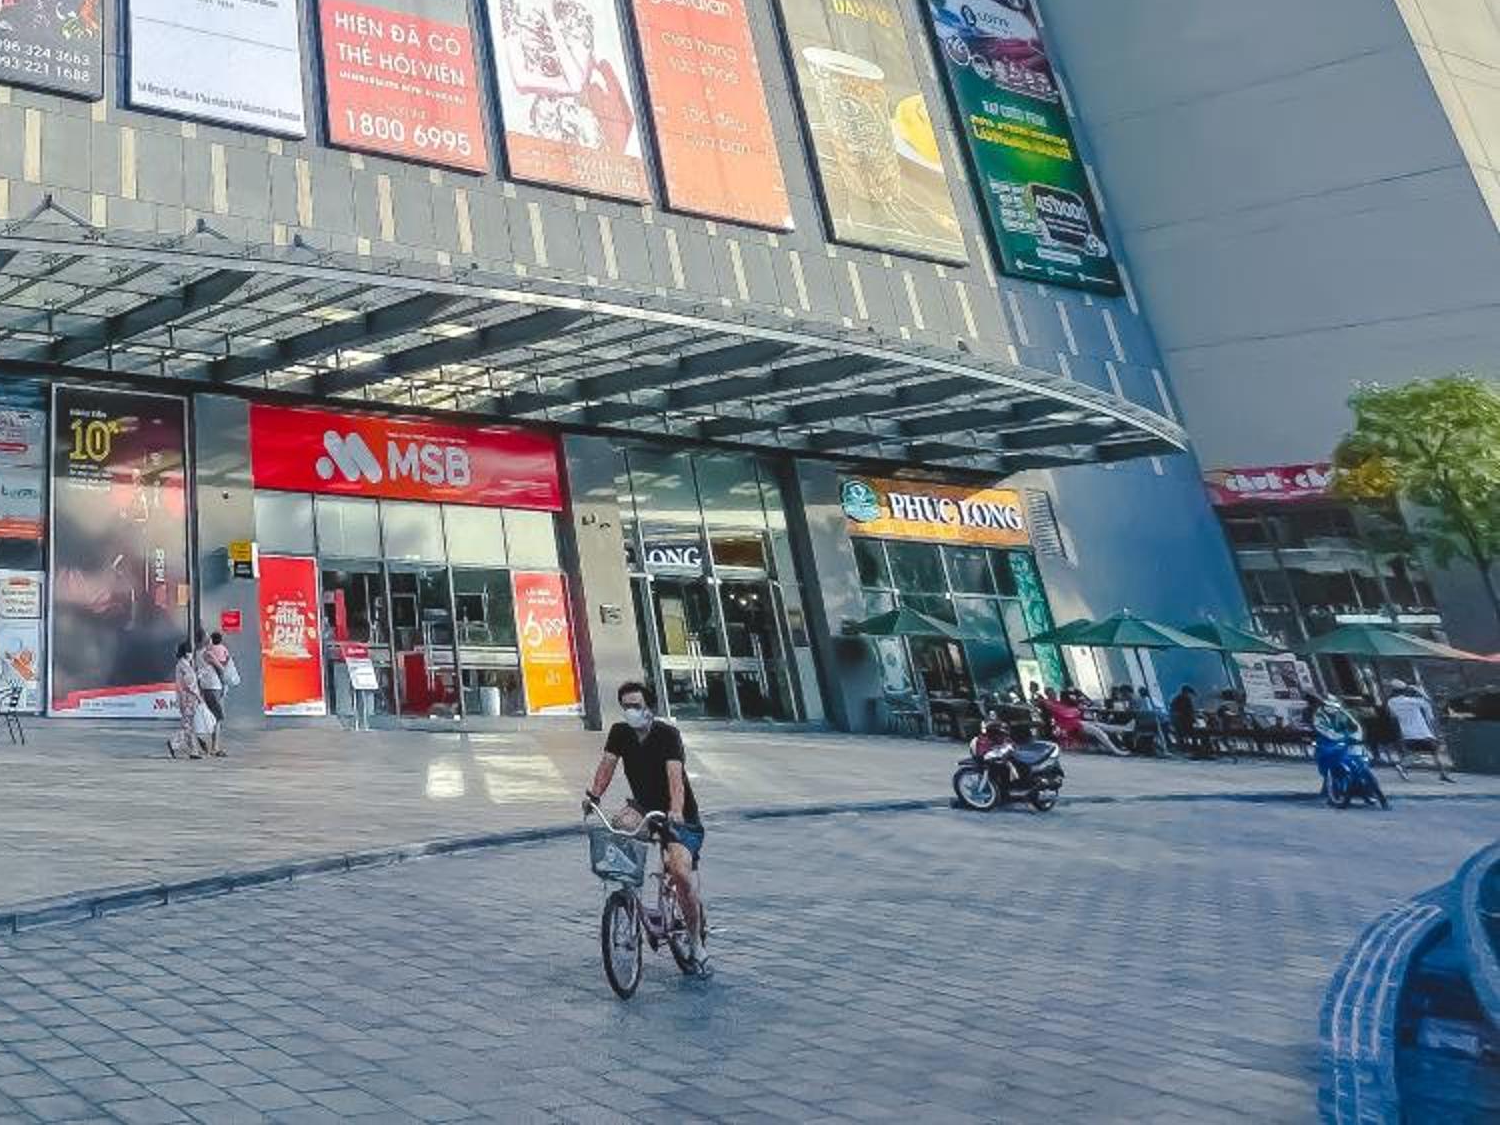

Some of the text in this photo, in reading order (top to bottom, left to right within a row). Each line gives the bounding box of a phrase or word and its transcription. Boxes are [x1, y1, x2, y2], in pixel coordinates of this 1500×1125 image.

[428, 31, 461, 56] CÓ
[24, 60, 50, 76] 221
[346, 109, 471, 156] 1800 6995
[388, 439, 471, 487] MSB
[958, 500, 1023, 530] LONG
[645, 546, 702, 568] ONG
